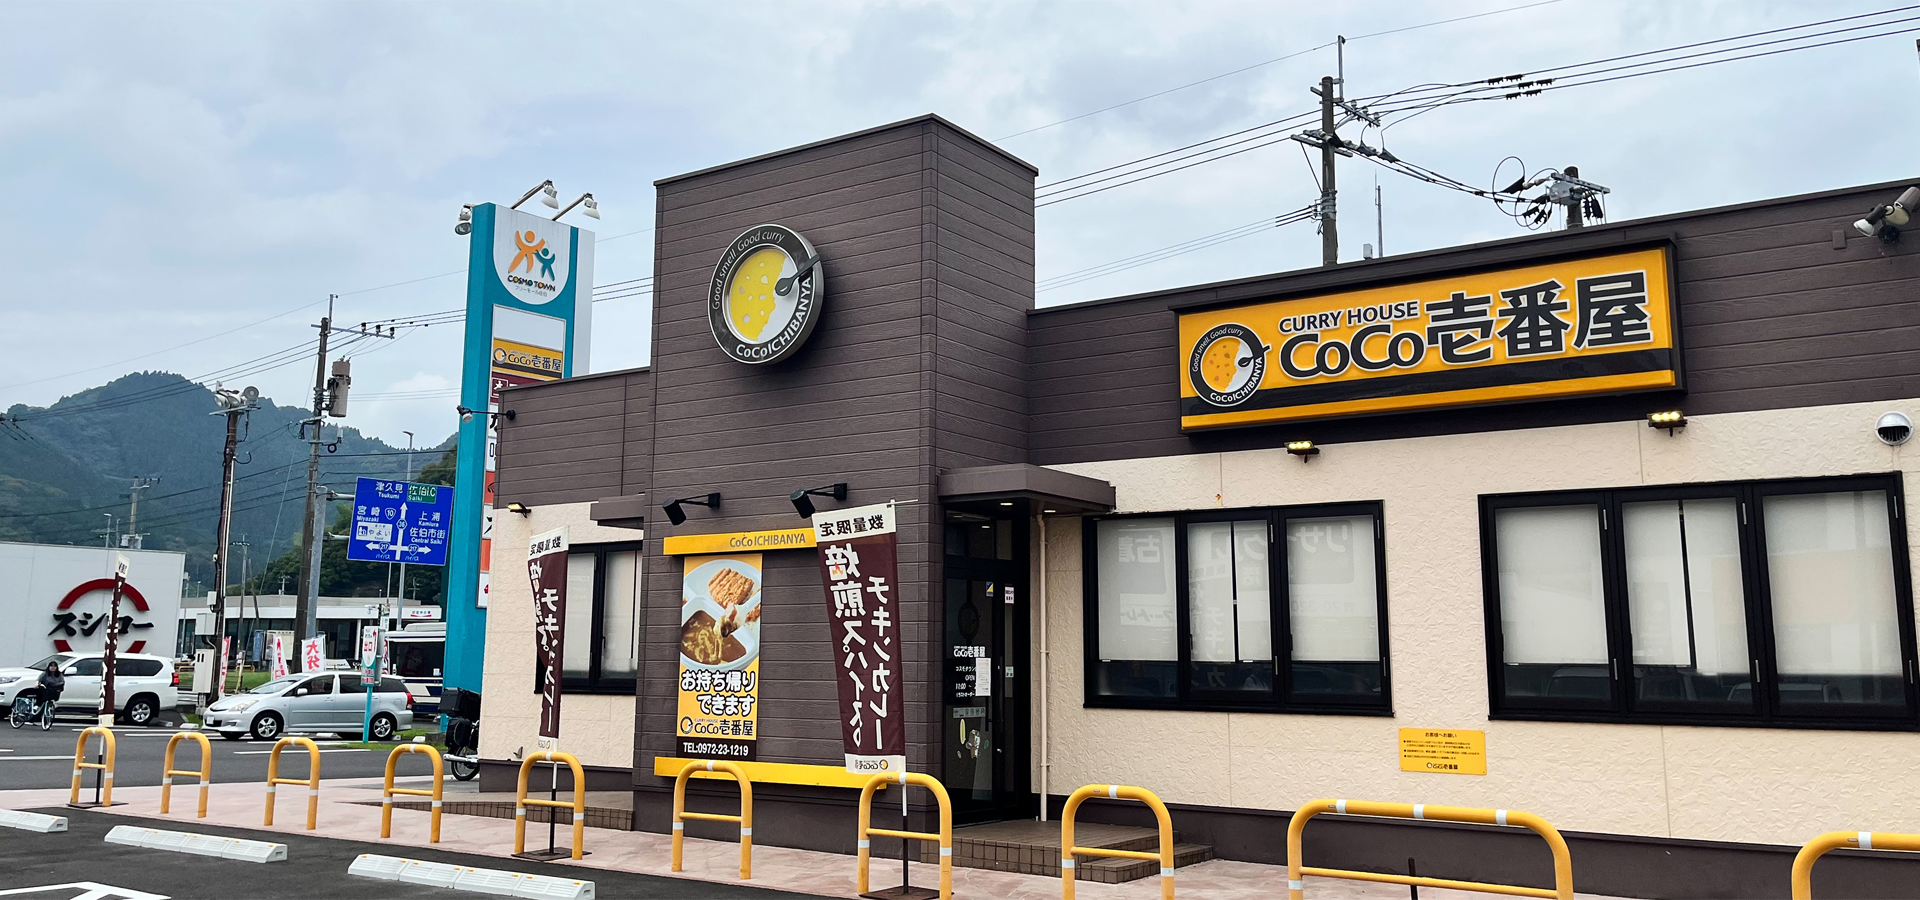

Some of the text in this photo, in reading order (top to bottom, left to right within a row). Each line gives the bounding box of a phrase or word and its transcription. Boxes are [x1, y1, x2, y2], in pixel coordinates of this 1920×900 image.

[712, 278, 723, 310] Good
[737, 231, 761, 251] Good
[761, 231, 785, 243] curry
[507, 275, 556, 292] COSMO TOWN
[1278, 300, 1419, 332] CURRY HOUSE
[1279, 269, 1653, 380] CoCo壱番屋
[1192, 353, 1200, 372] Good
[1210, 327, 1227, 339] Good
[1227, 328, 1244, 336] curry
[508, 353, 562, 371] CoCo壱番屋
[375, 481, 404, 494] 津久見
[357, 505, 381, 516] 宮崎
[419, 510, 441, 522] 上浦
[409, 527, 446, 539] 佐伯市街
[681, 669, 756, 693] お持ち帰り
[696, 693, 756, 718] できます
[694, 718, 754, 736] CoCo壱番屋
[683, 742, 749, 756] TEL:0972-23-1219
